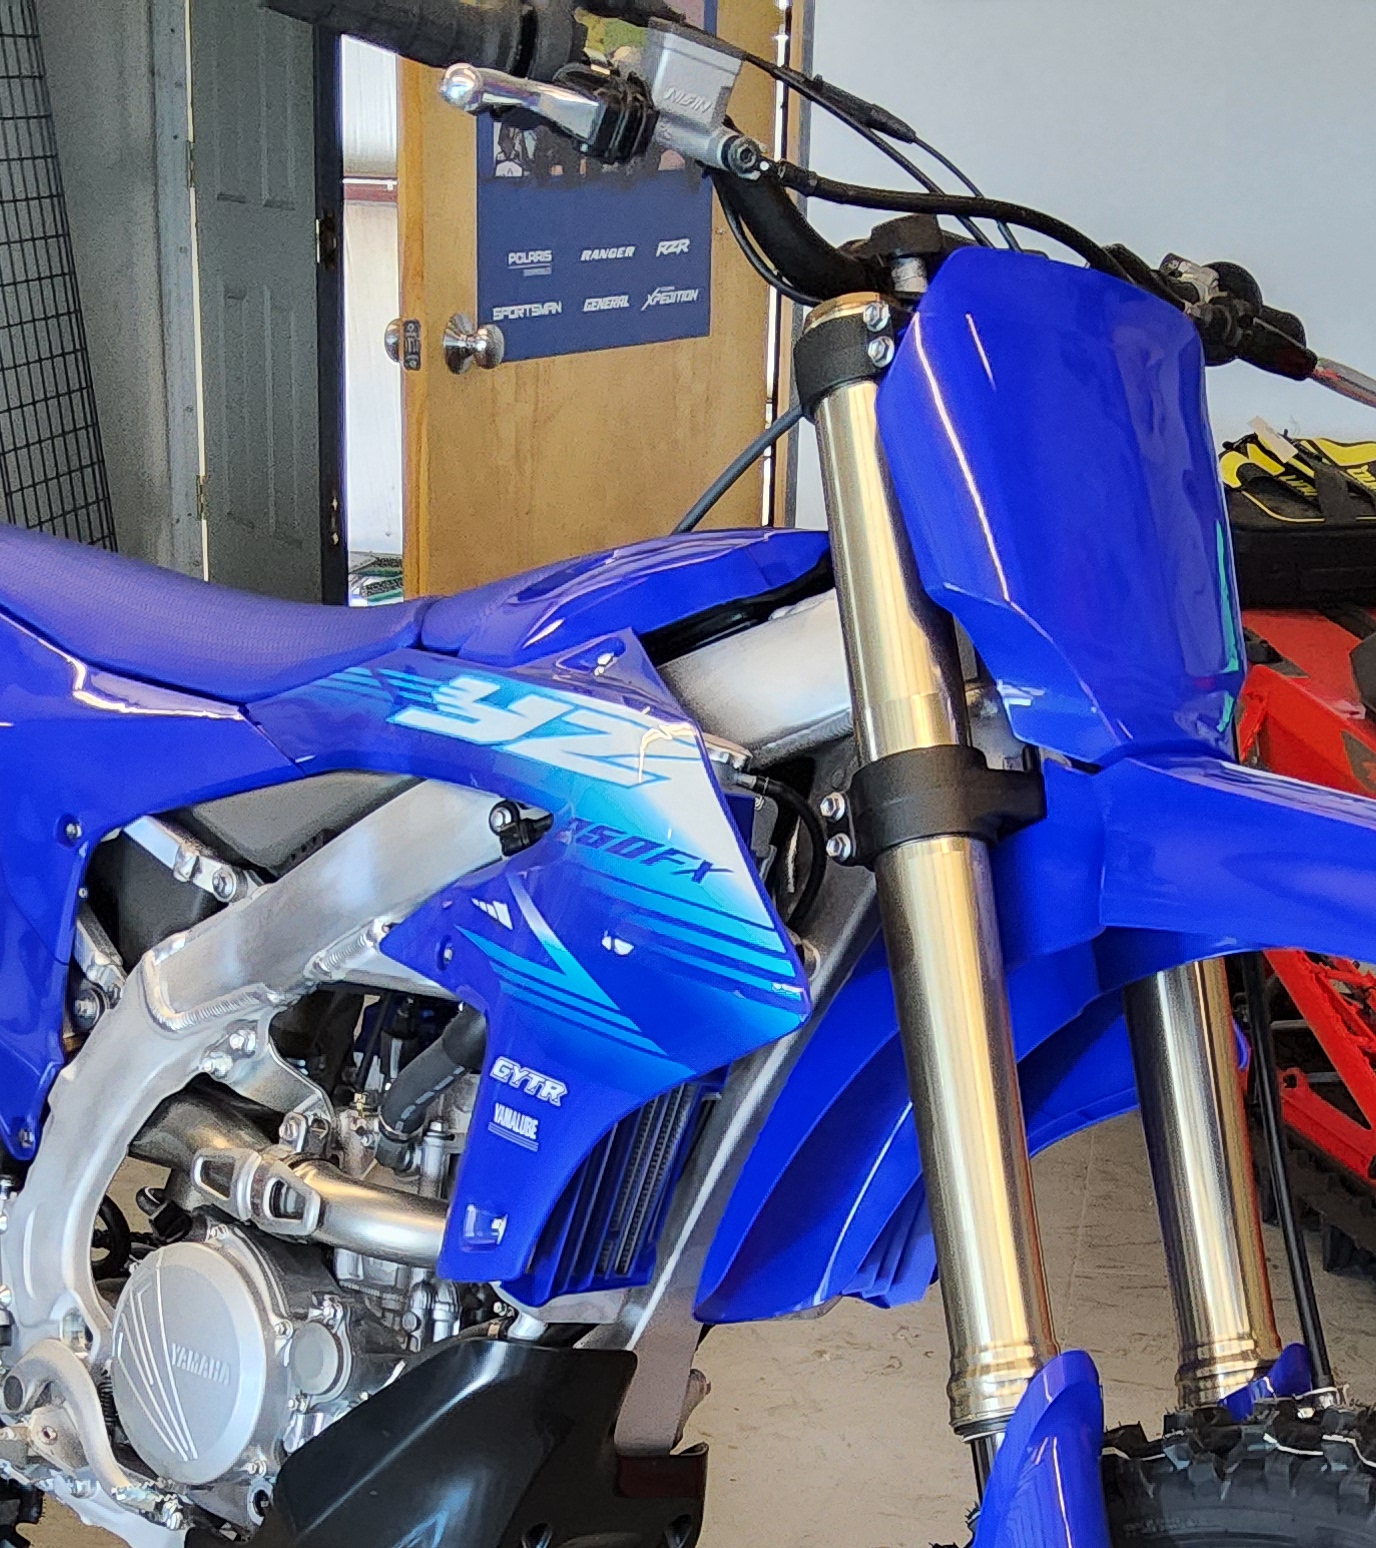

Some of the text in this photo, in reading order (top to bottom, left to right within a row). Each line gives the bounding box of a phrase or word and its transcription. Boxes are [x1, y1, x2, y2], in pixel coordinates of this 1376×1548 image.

[508, 238, 691, 265] POLARIS RANGER RZR
[493, 288, 699, 321] SPORTSMAN GENERAL XPEDITION
[387, 673, 702, 789] YZ
[489, 1055, 569, 1107] GYTR
[493, 1101, 539, 1140] YAMALUBE
[171, 1342, 232, 1386] YAMAHA
